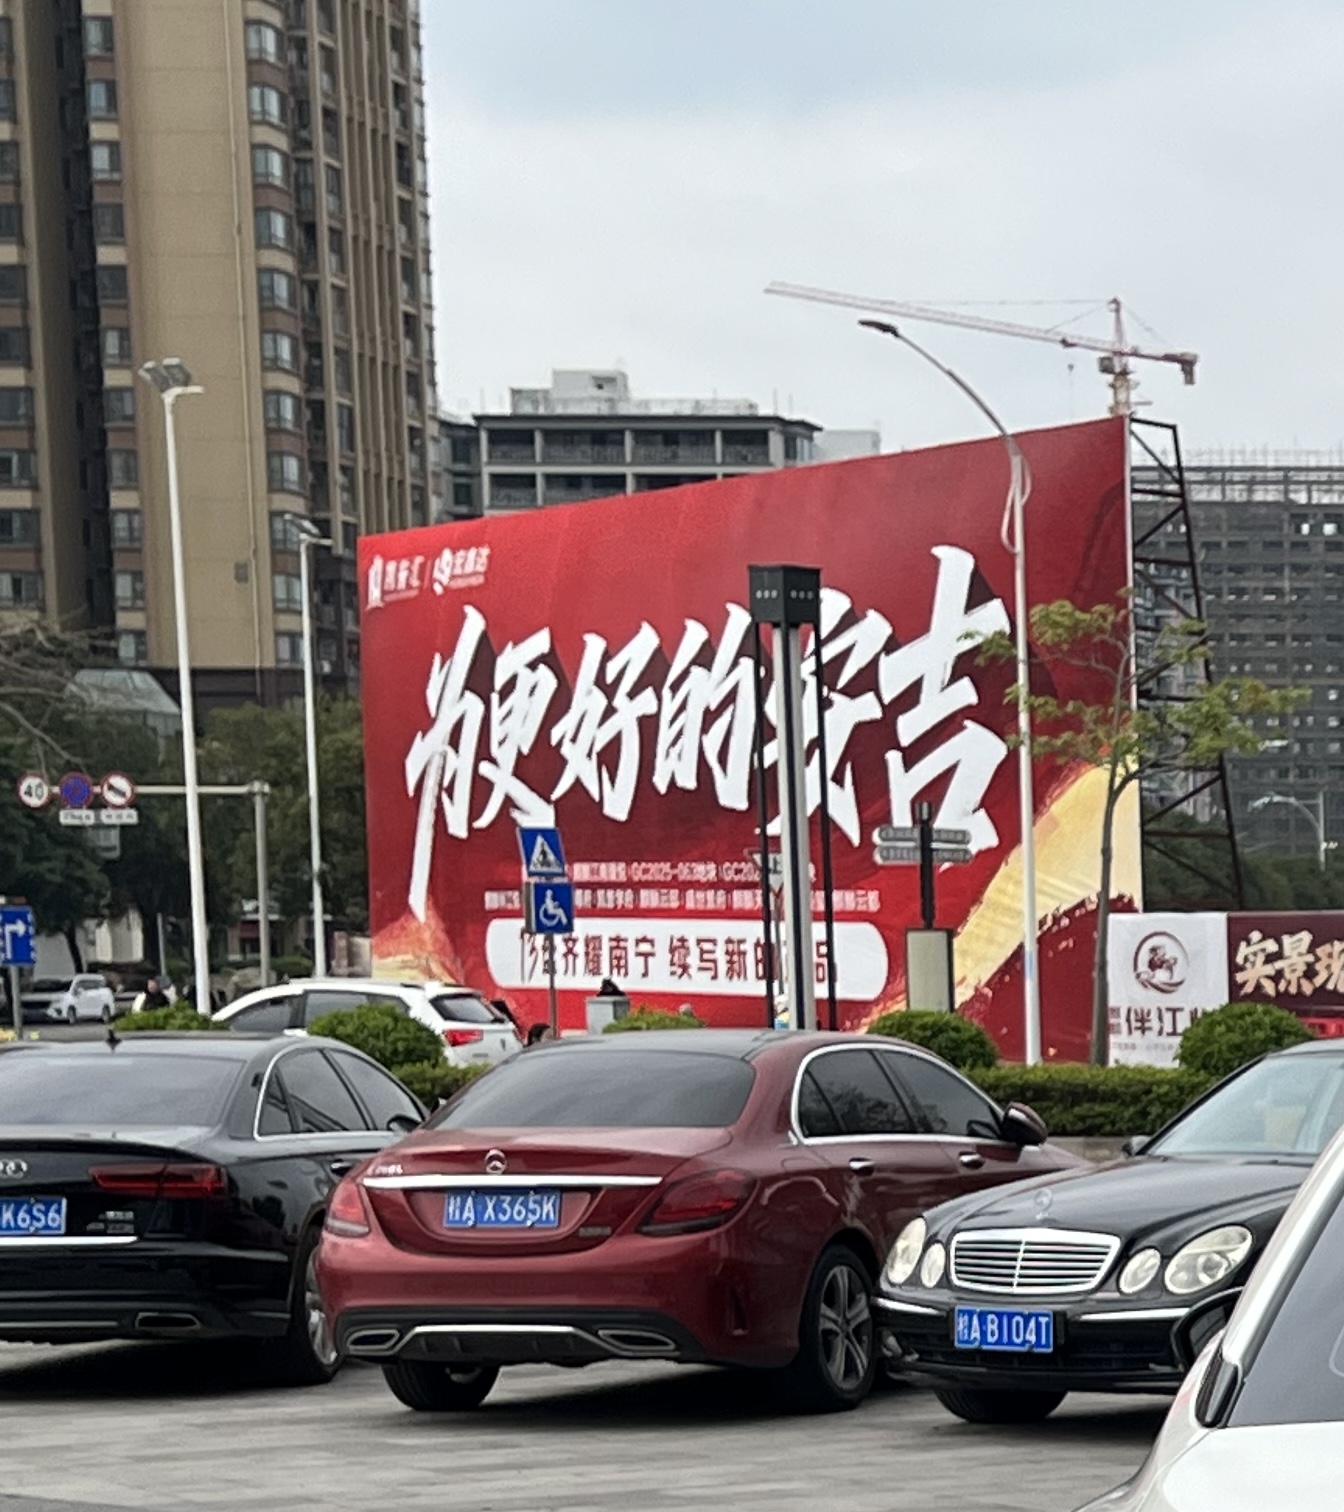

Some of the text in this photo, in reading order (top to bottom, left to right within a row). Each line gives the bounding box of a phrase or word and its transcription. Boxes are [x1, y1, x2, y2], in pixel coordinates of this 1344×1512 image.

[24, 780, 44, 802] 40
[668, 934, 838, 984] 续写新的品
